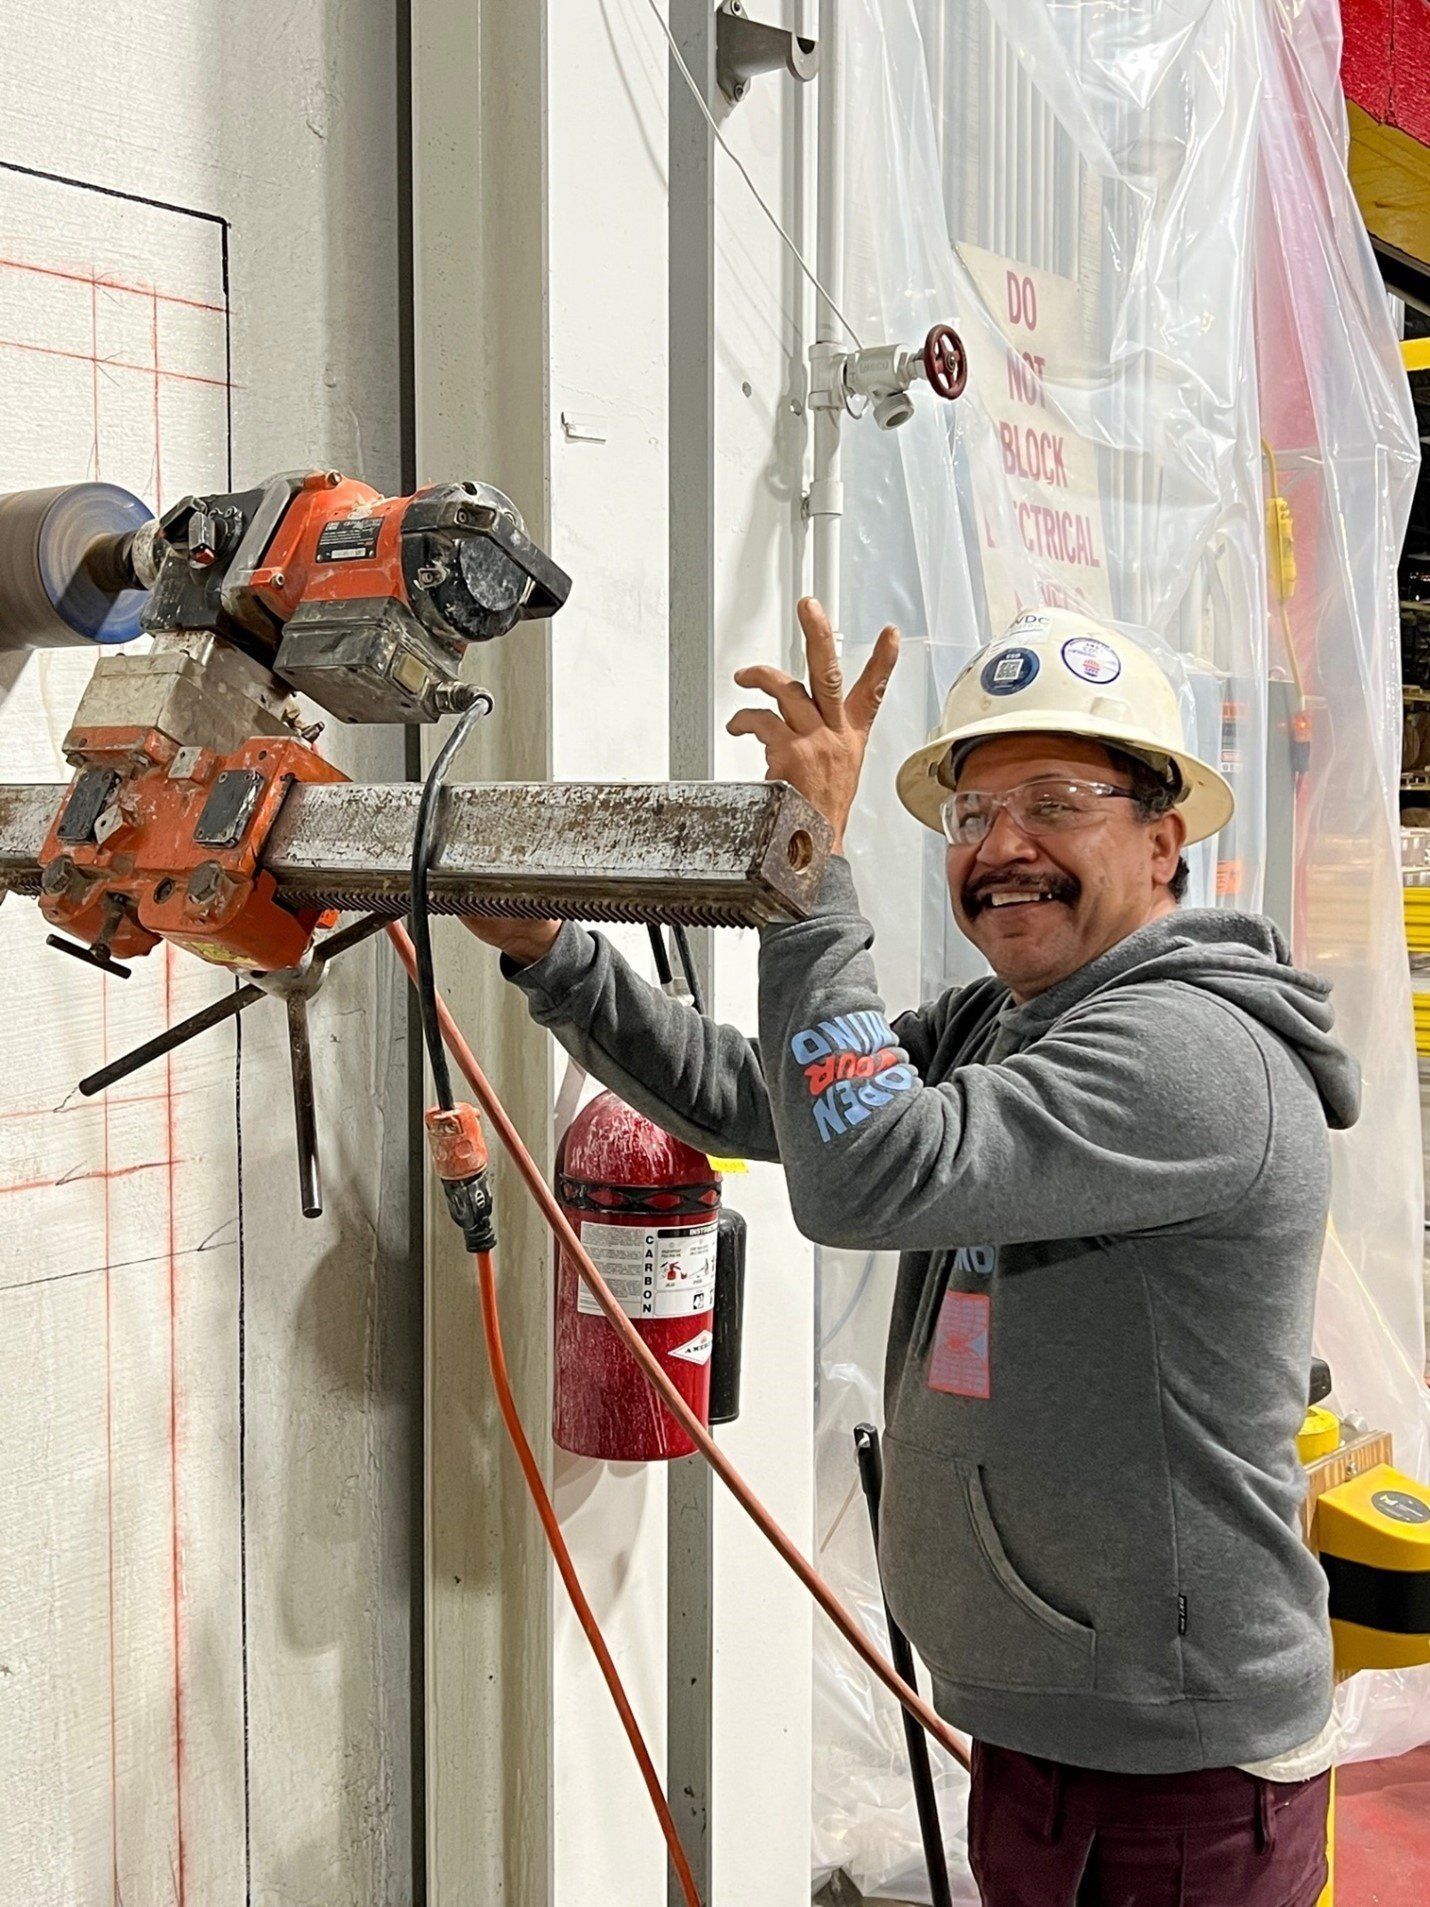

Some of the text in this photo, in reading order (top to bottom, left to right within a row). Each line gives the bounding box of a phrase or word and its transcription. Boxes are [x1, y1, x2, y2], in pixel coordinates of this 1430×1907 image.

[1006, 270, 1037, 331] DO
[1007, 350, 1046, 410] NOT
[999, 420, 1068, 488] BLOCK
[984, 500, 1100, 568] CTRICAL
[790, 1010, 894, 1065] MIND
[812, 1063, 912, 1143] OPEN
[642, 1235, 655, 1313] CARBON
